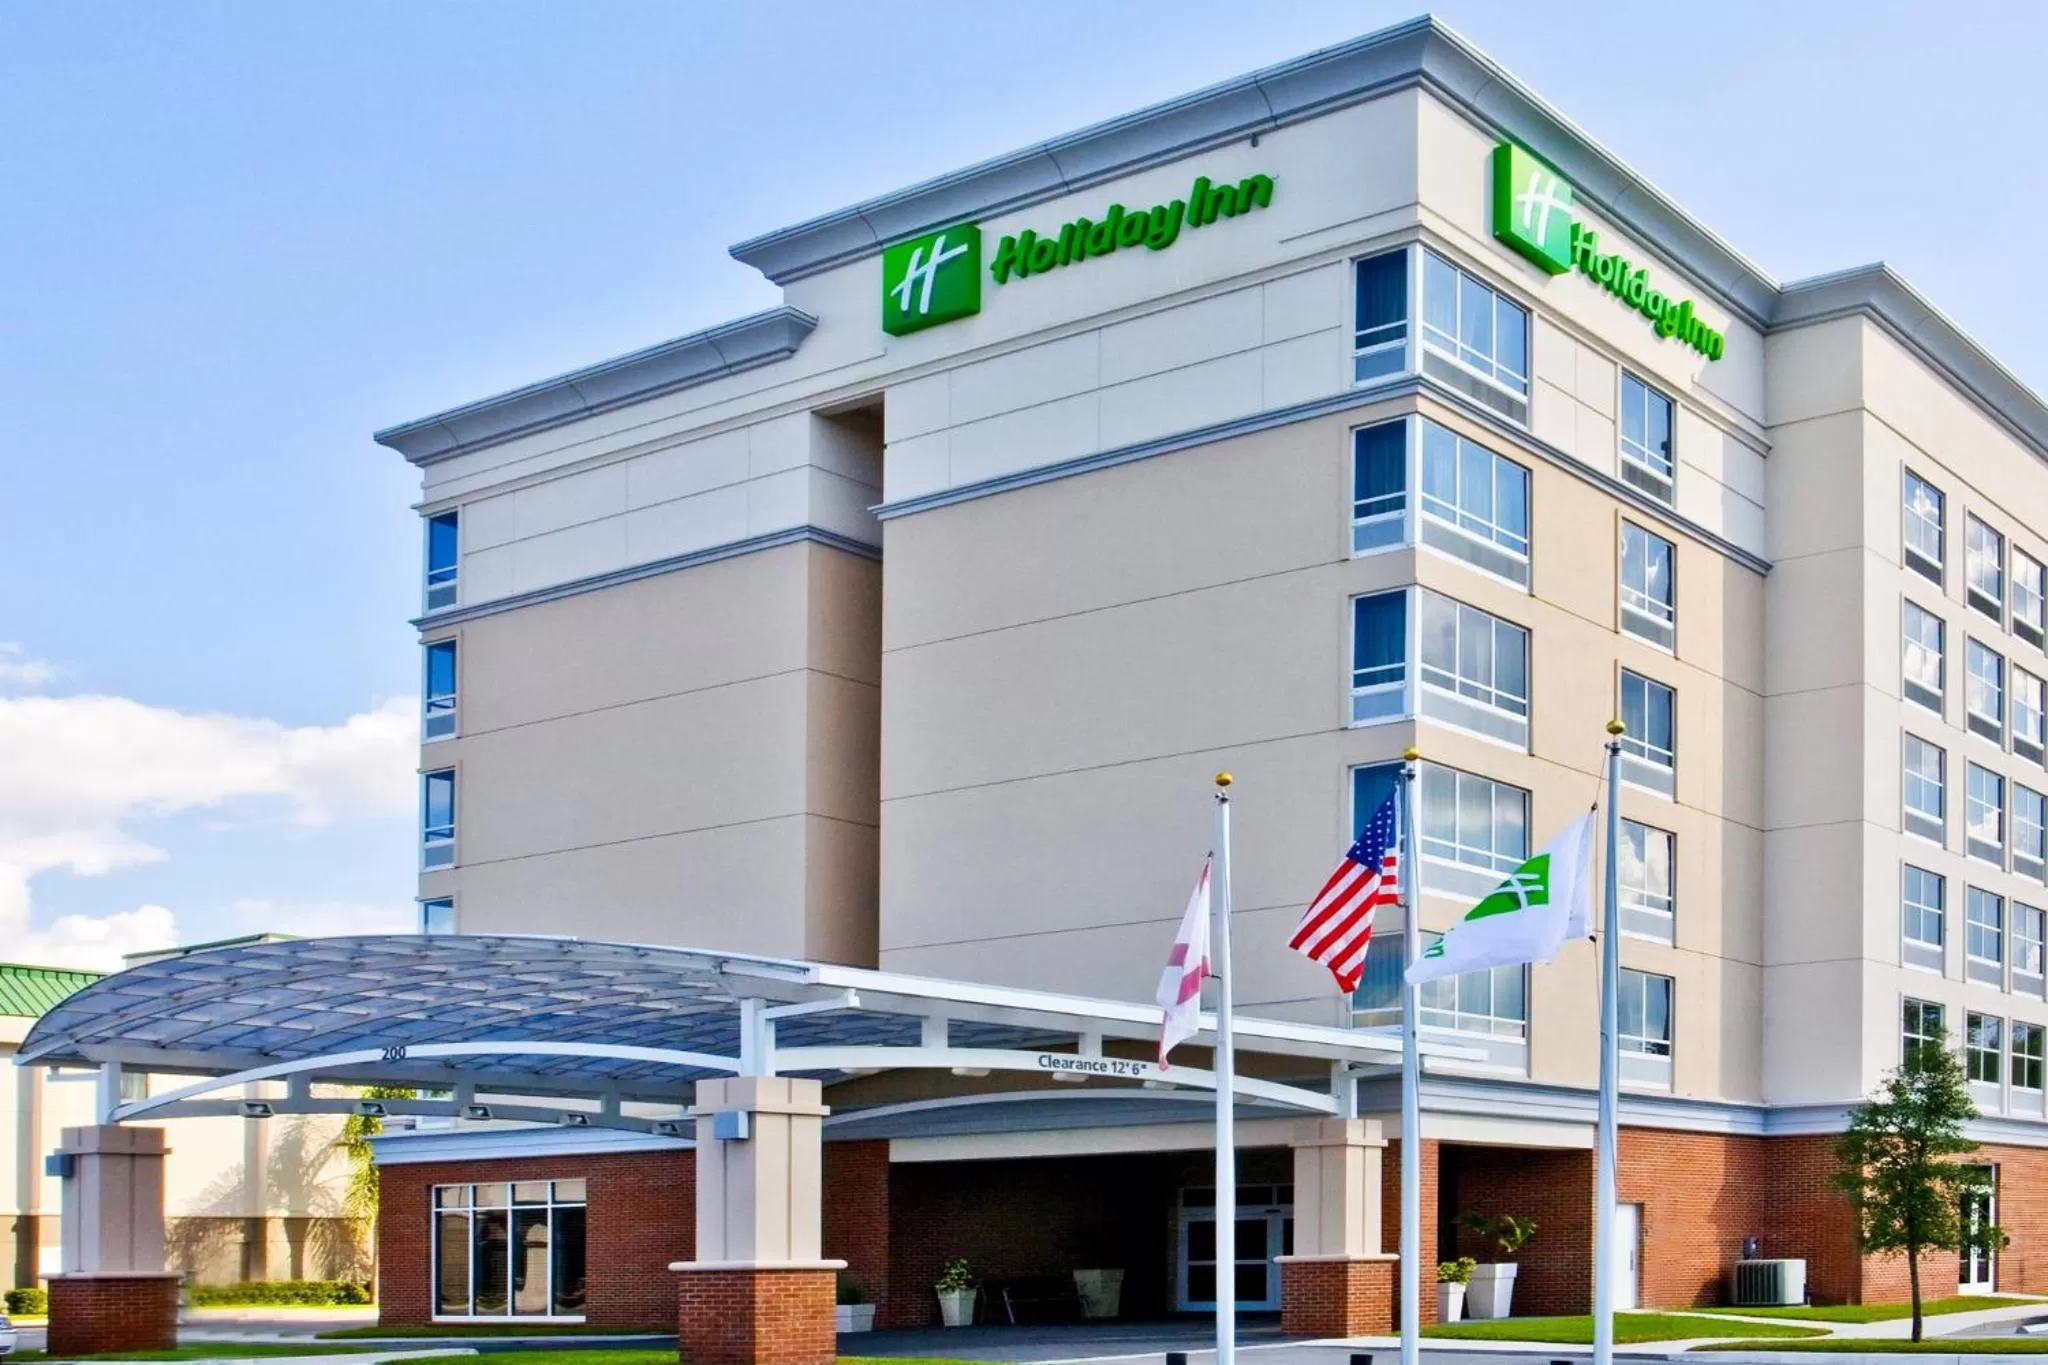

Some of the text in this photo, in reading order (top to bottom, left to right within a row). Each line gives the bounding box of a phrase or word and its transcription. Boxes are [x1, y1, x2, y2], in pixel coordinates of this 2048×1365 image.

[990, 175, 1275, 285] Holiday Inn
[1571, 222, 1724, 361] Holiday Inn
[382, 1046, 406, 1061] 200
[1038, 1054, 1108, 1073] Clearance
